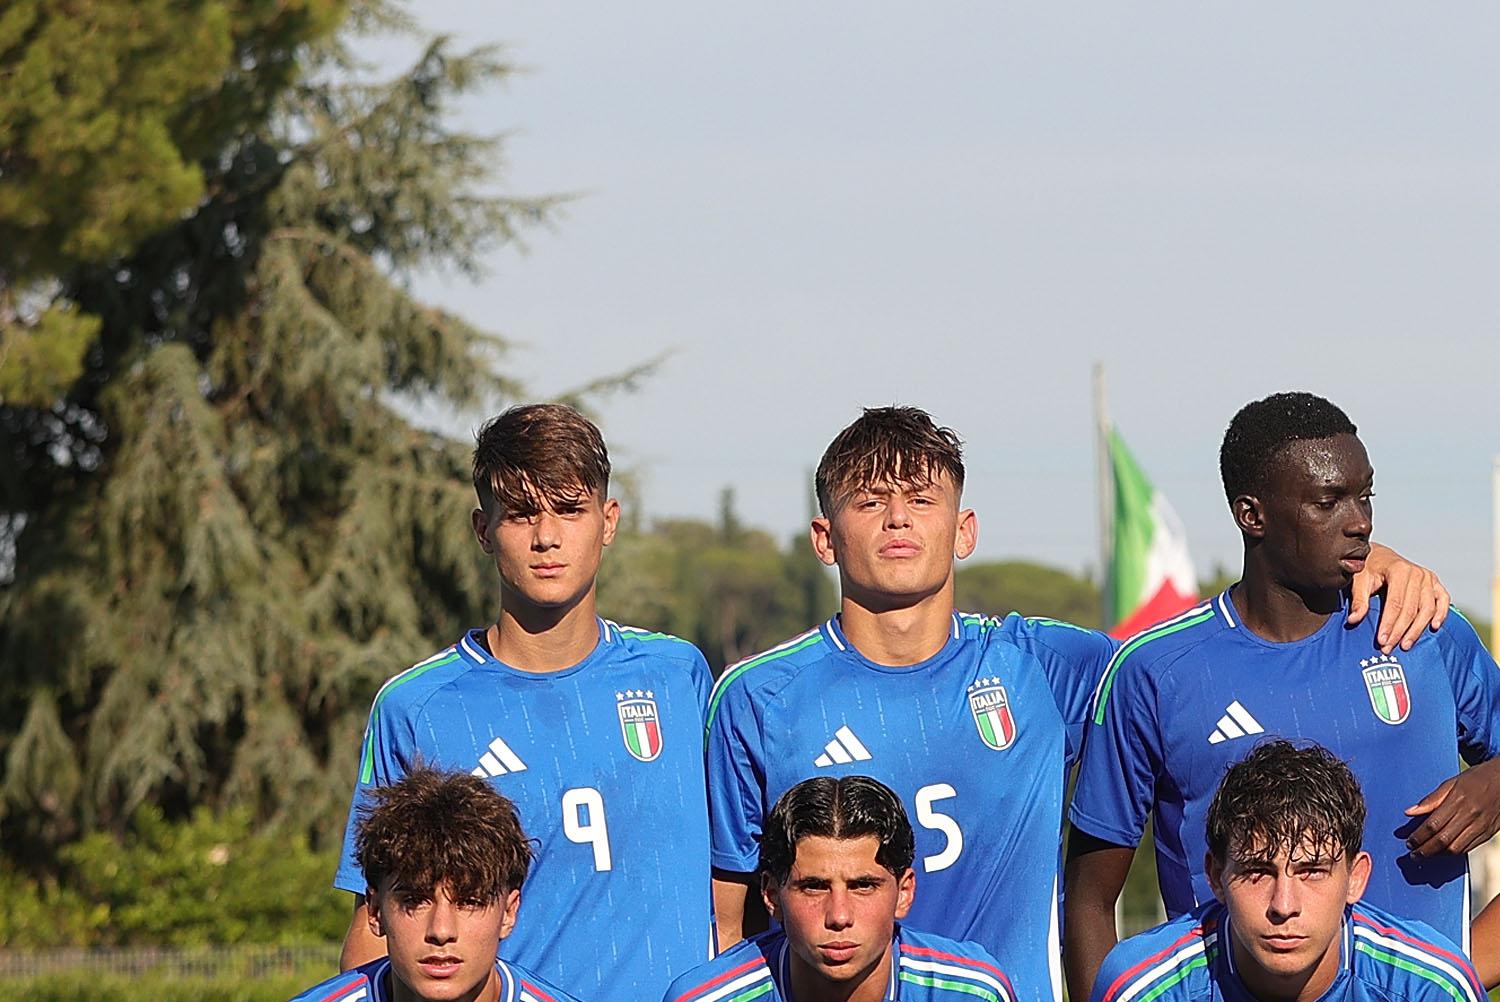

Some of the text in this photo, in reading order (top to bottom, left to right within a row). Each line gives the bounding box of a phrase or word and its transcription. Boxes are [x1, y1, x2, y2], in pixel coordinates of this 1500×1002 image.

[1366, 668, 1401, 684] ITALIA
[972, 690, 1005, 710] ITALIA
[621, 705, 655, 719] ITALIA
[562, 787, 612, 872] 9
[914, 783, 963, 873] 5
